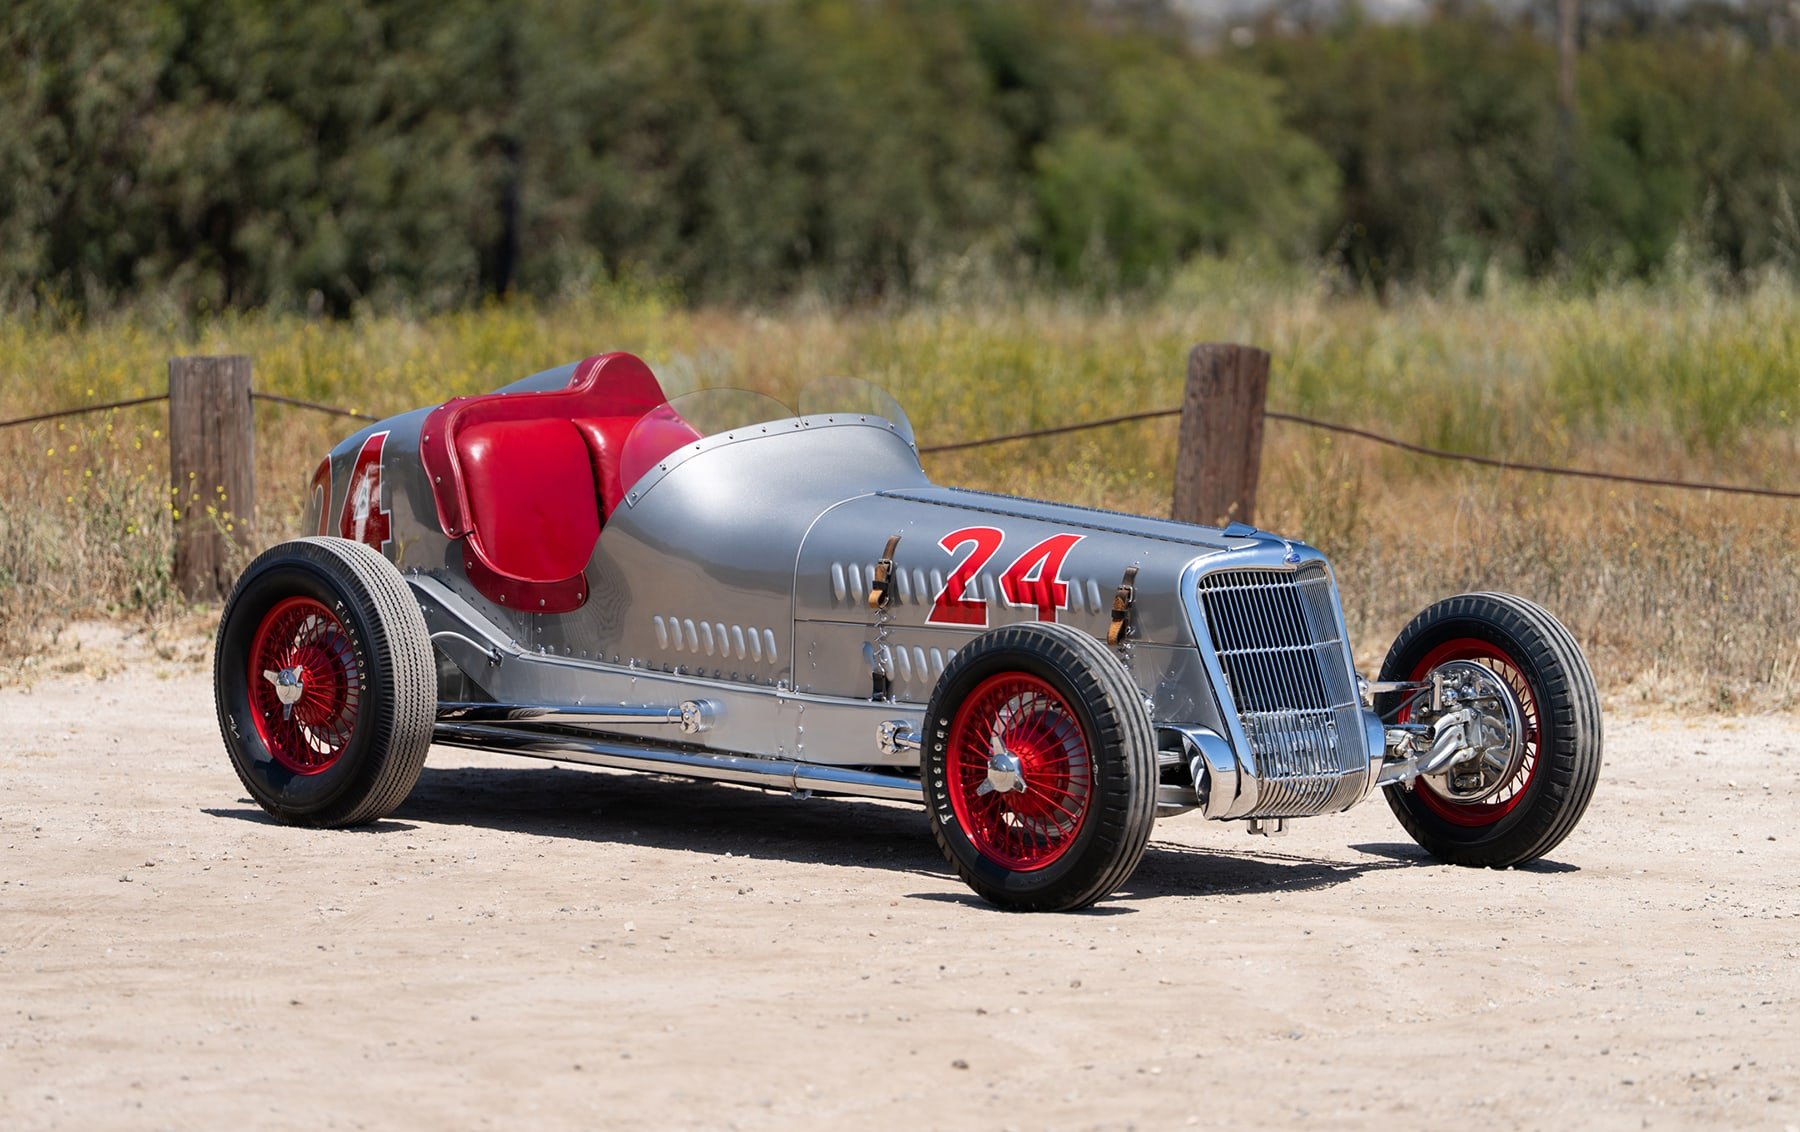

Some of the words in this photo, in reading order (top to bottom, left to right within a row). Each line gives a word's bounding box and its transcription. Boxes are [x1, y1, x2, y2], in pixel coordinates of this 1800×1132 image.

[310, 430, 391, 557] 24
[924, 525, 1088, 629] 24
[335, 600, 367, 691] Firestone
[932, 718, 953, 825] Firestone
